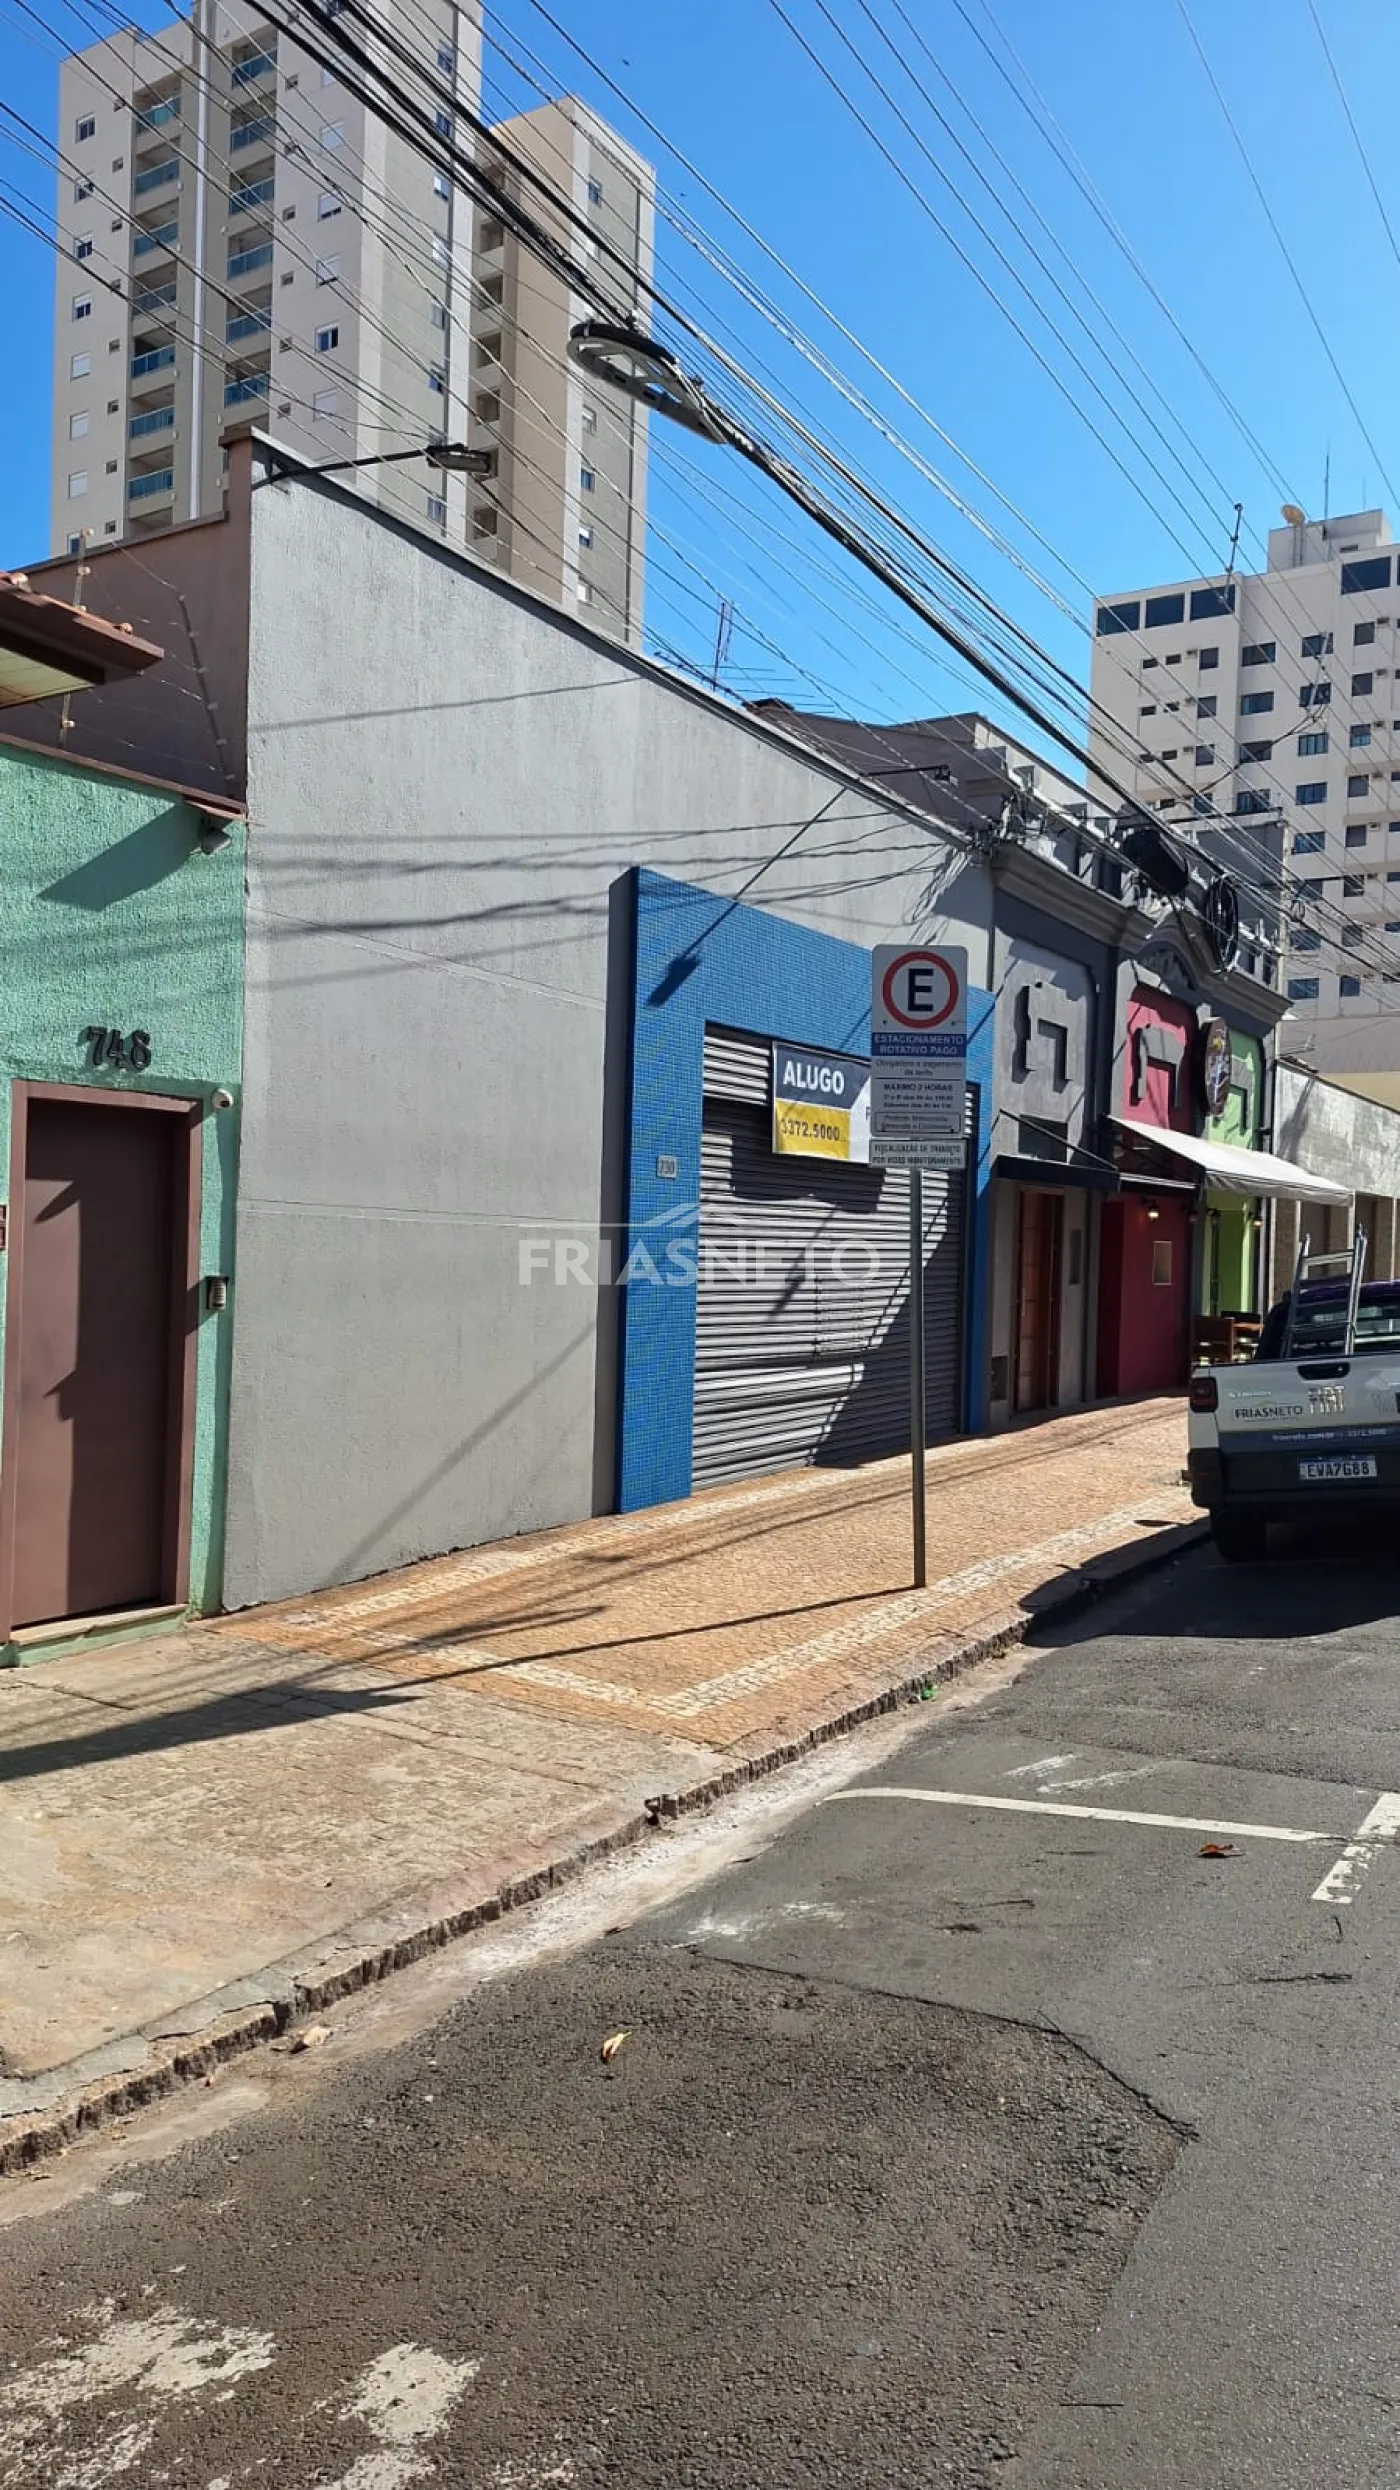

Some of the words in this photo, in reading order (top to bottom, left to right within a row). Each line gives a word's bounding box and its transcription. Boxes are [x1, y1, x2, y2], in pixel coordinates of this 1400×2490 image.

[908, 968, 934, 1012] E
[86, 1025, 152, 1071] 748
[874, 1034, 963, 1045] ESTACIONAMENTO
[879, 1045, 928, 1054] ROTATIVO
[930, 1046, 957, 1055] PAGO
[783, 1060, 845, 1095] ALUGO
[781, 1118, 840, 1141] 3372.5000
[1235, 1406, 1303, 1419] FRIASNETO
